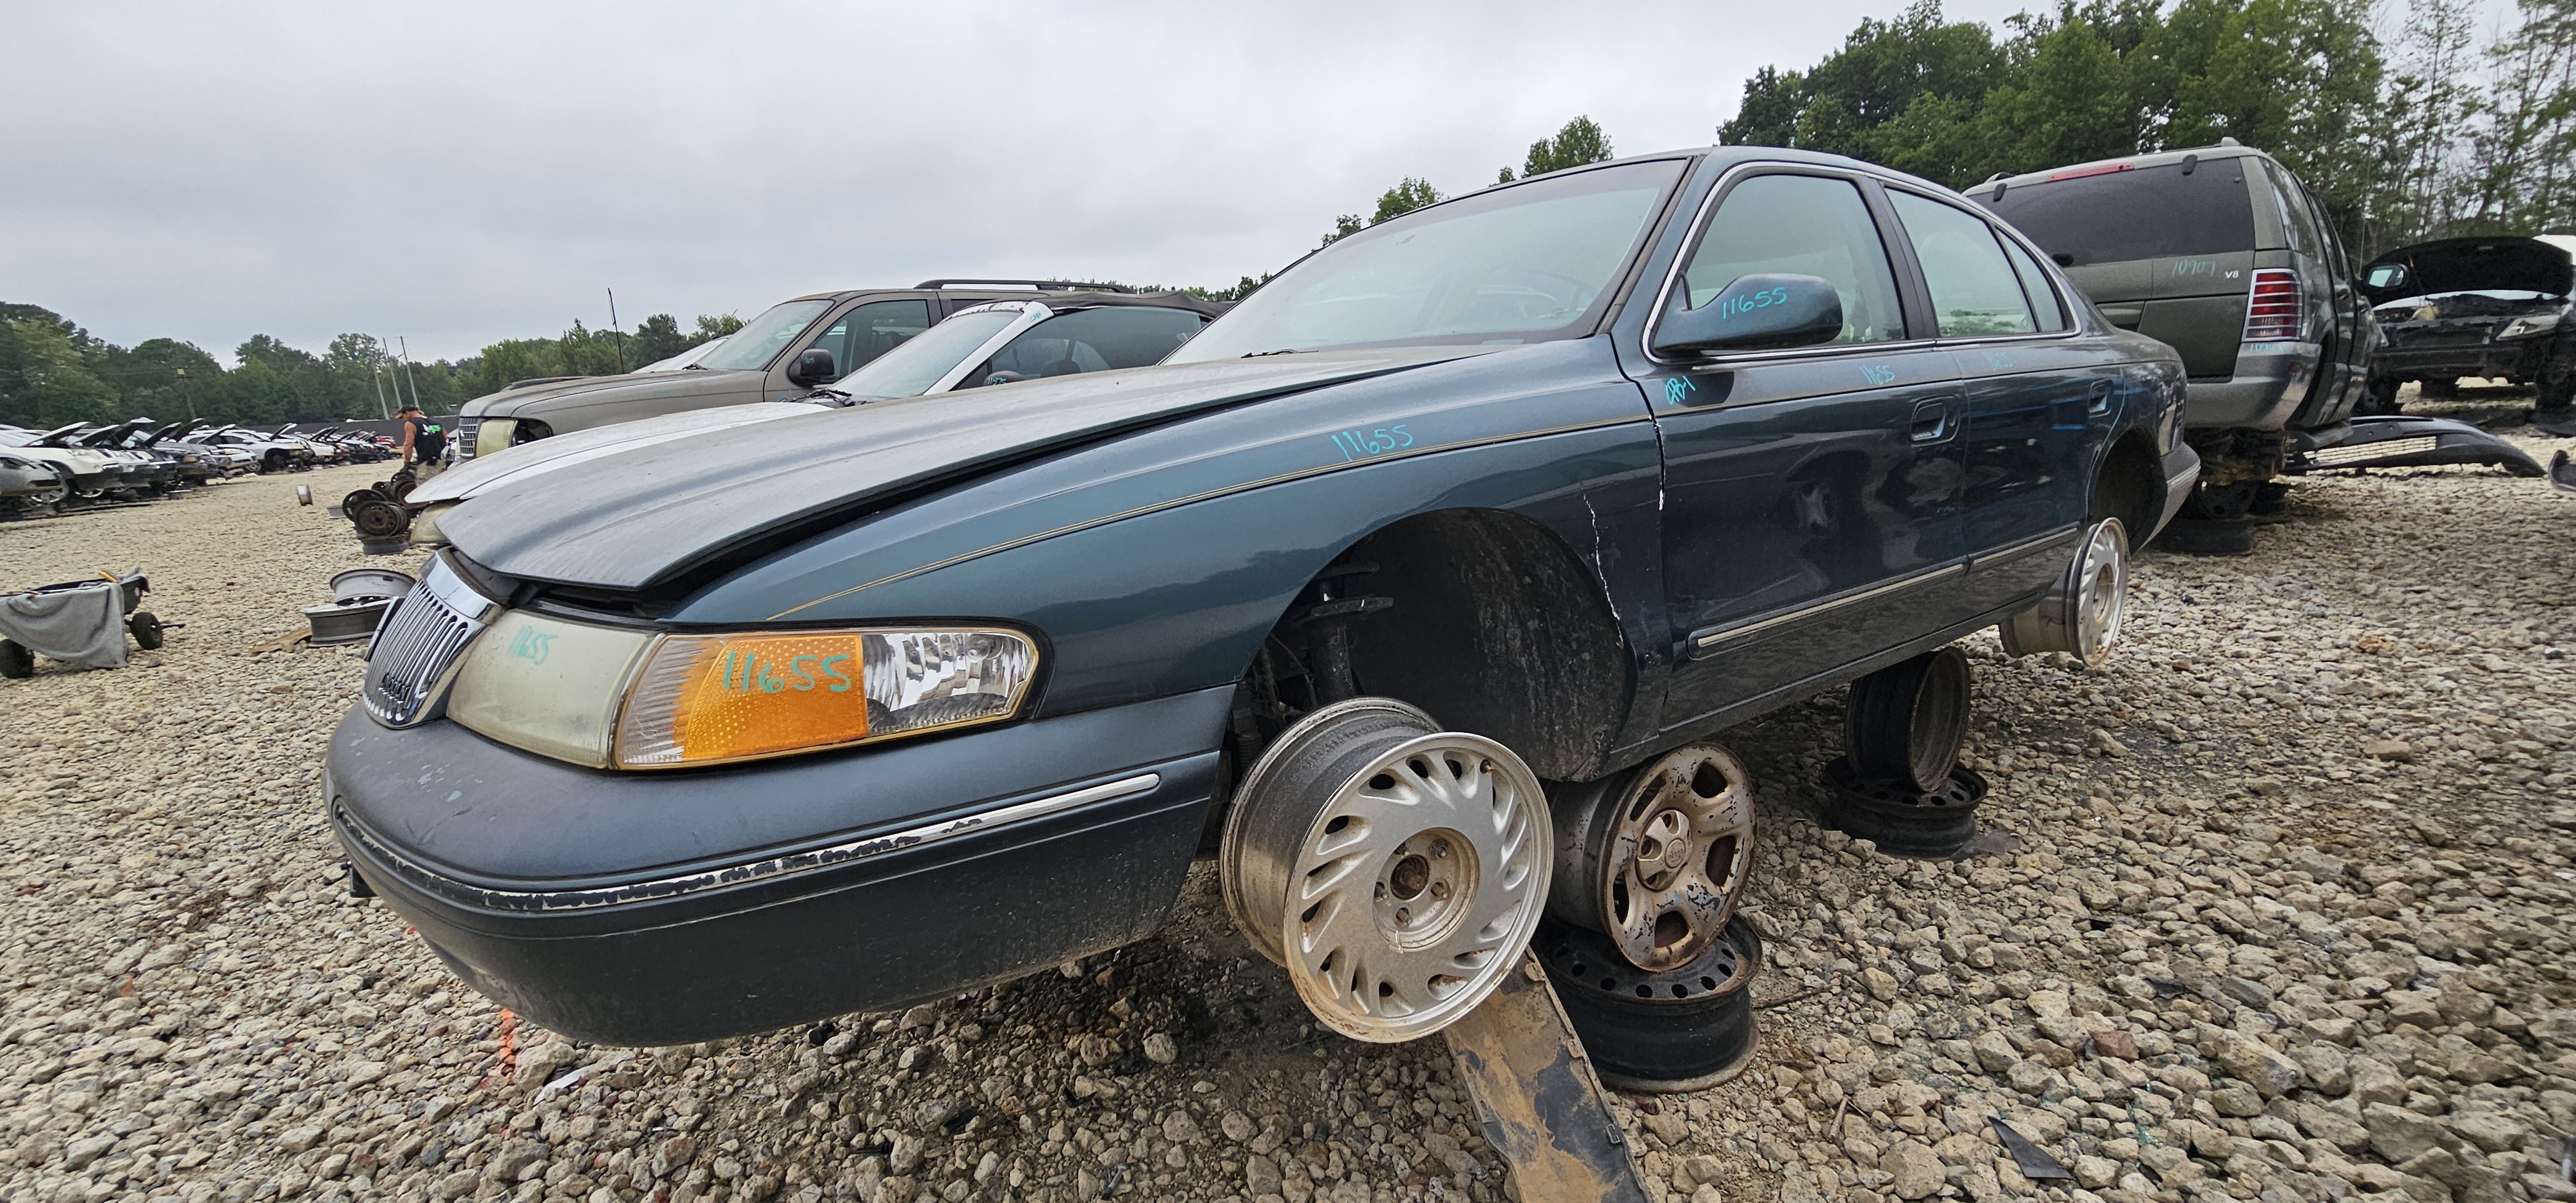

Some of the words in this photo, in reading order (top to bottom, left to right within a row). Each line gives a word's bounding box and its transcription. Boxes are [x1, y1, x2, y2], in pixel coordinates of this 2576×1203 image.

[2224, 270, 2239, 279] V8
[1722, 286, 1788, 319] 11655
[1331, 424, 1414, 462] 11655
[379, 672, 410, 704] NCOLN
[723, 650, 852, 694] 11655
